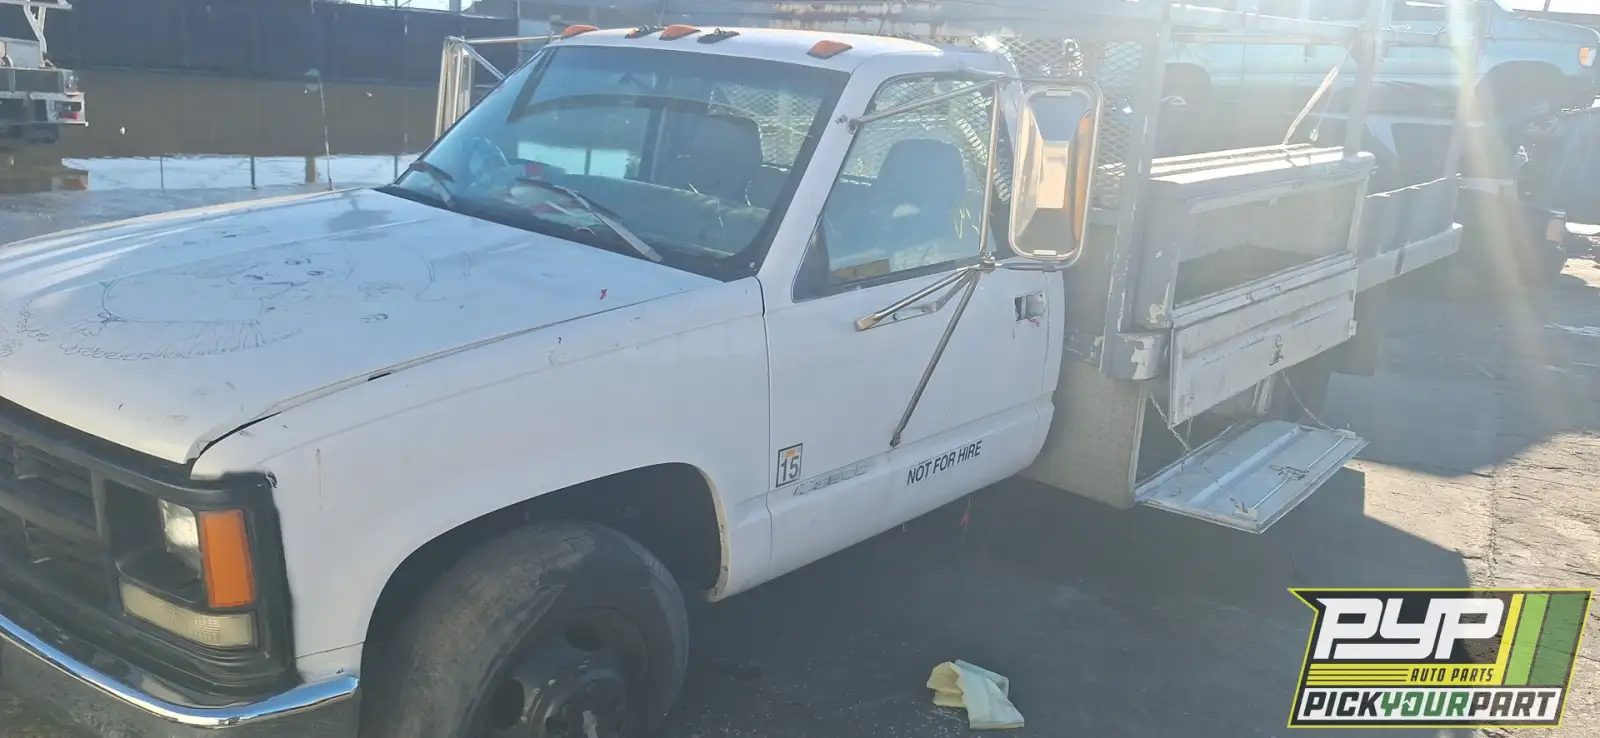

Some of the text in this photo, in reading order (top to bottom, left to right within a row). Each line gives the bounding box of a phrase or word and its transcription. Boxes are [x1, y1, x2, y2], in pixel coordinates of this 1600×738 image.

[781, 456, 800, 482] 15
[907, 440, 983, 486] NOT FOR HIRE
